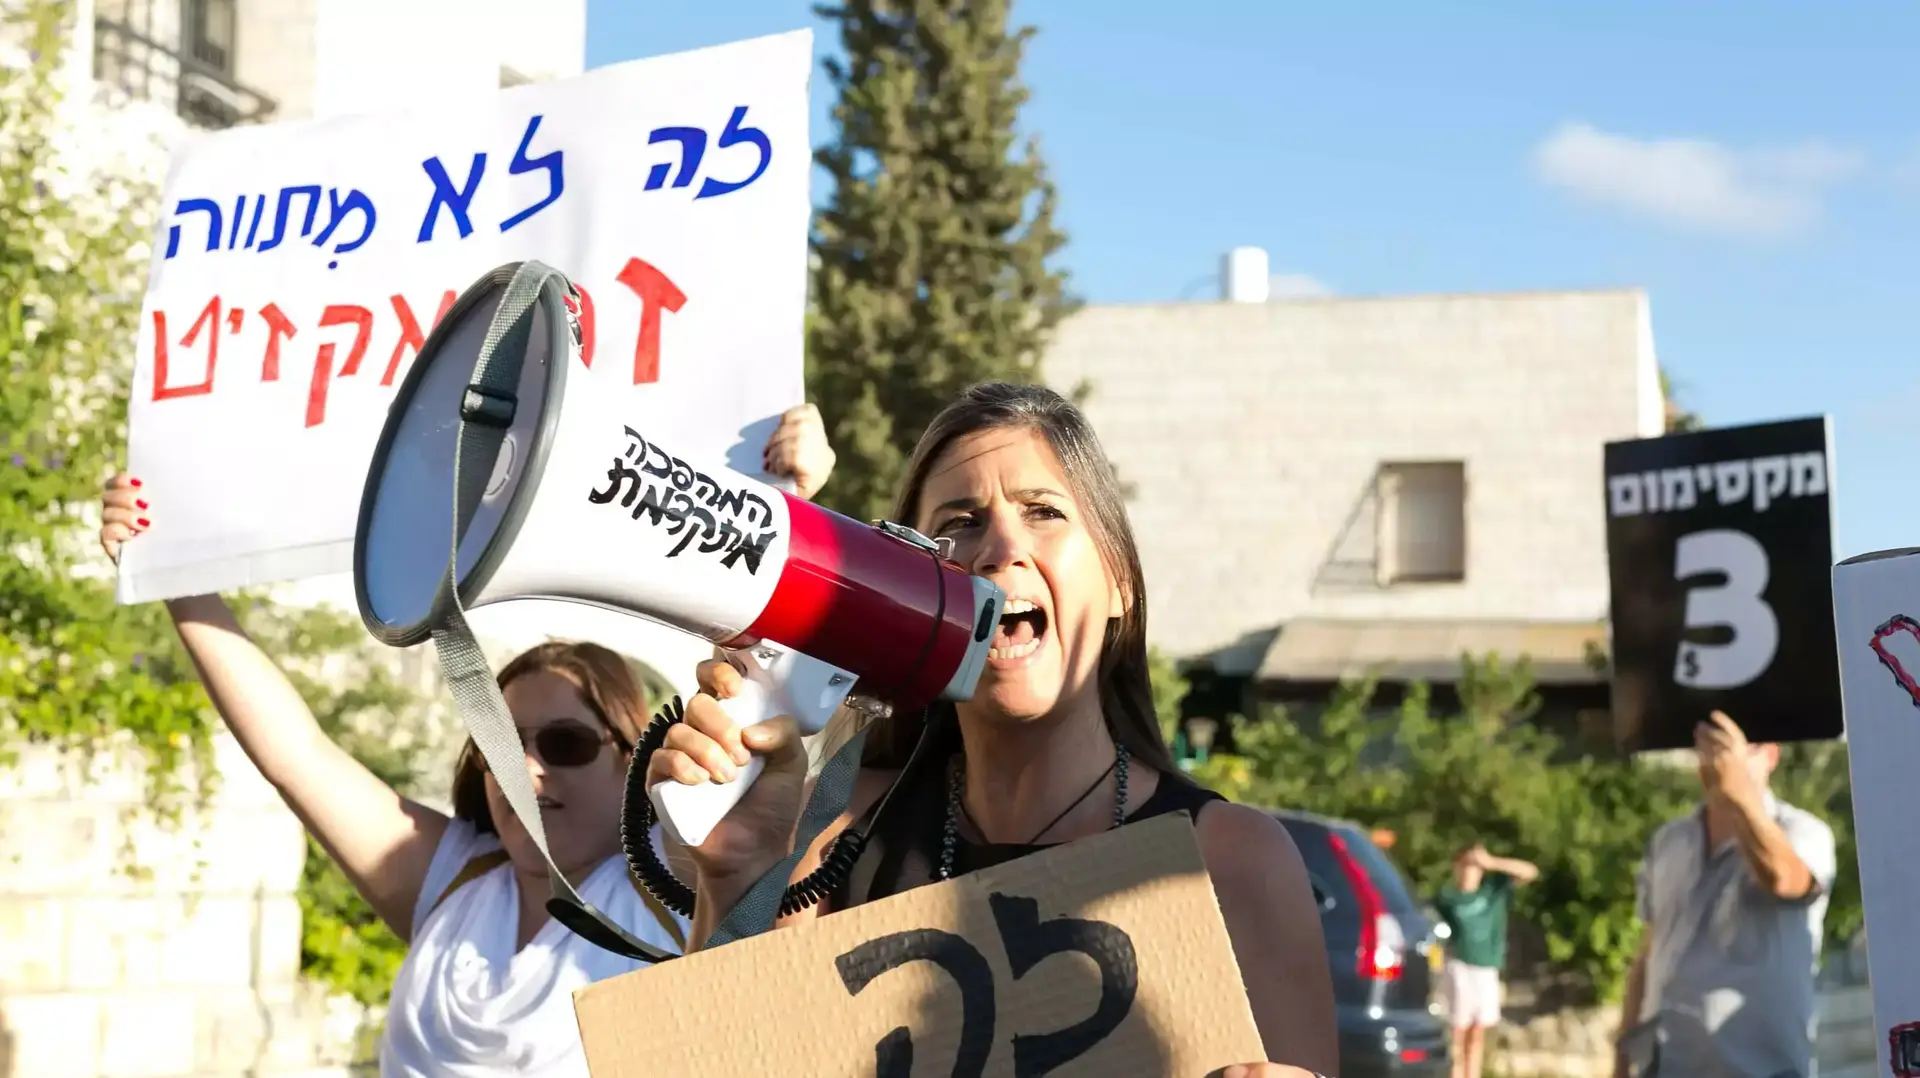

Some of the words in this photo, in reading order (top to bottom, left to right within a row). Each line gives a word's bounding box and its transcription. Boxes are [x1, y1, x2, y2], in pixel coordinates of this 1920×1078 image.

[417, 114, 565, 243] לא
[643, 105, 773, 201] זה
[623, 425, 773, 529] המהפכה
[1609, 451, 1827, 517] מקסימום
[1673, 528, 1780, 690] 3
